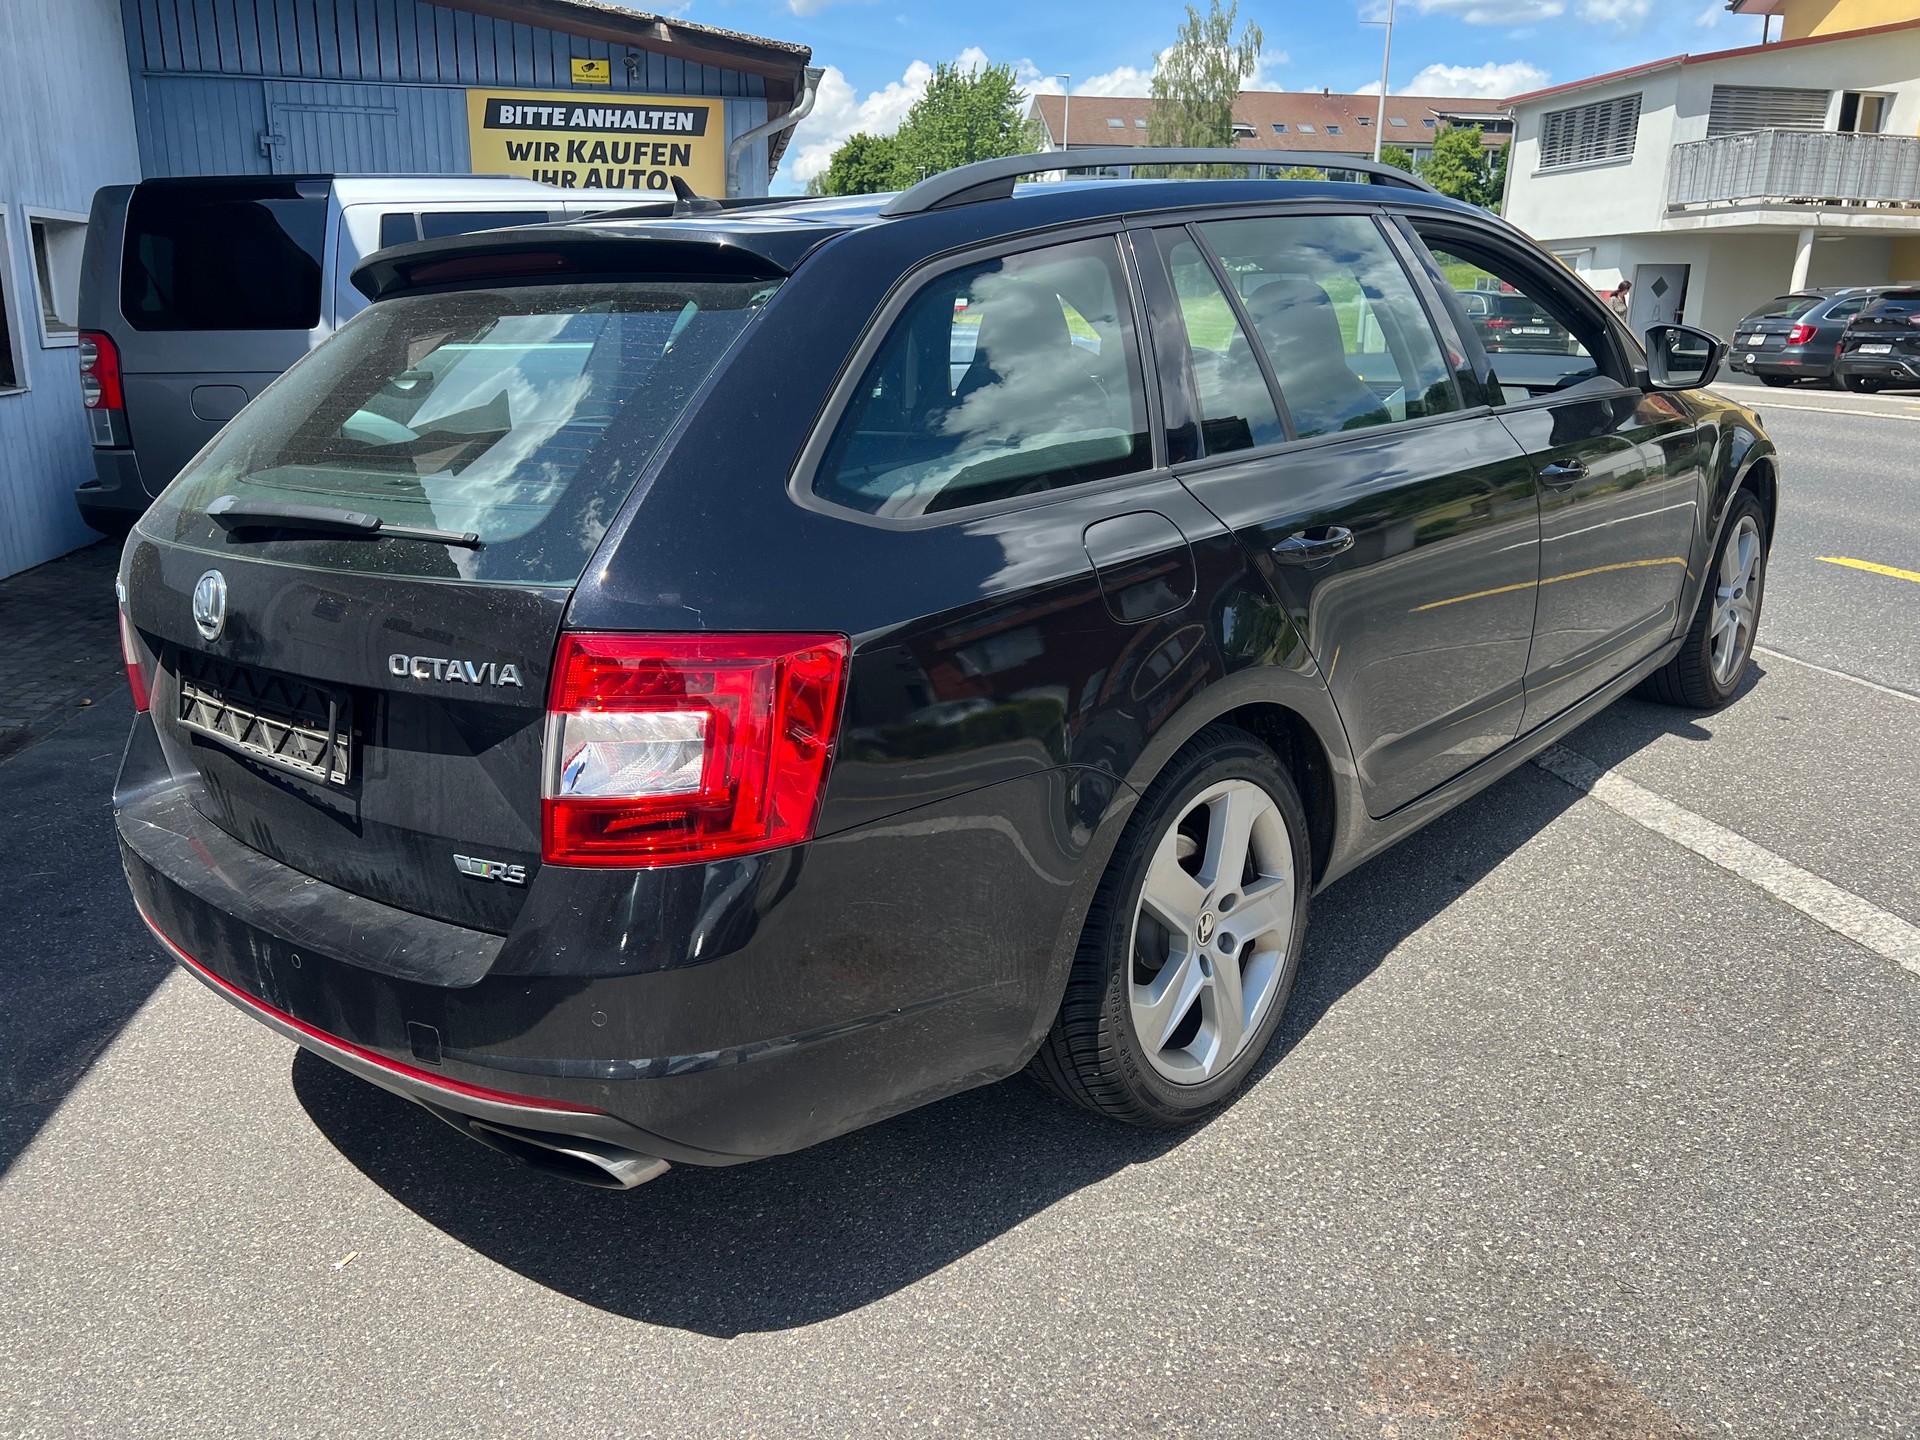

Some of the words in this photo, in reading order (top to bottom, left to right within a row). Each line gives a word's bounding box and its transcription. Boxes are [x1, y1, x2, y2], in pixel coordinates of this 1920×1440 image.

[500, 105, 567, 126] BITTE
[569, 109, 694, 131] ANHALTEN
[505, 141, 560, 163] WIR
[566, 139, 692, 167] KAUFEN
[532, 169, 577, 189] IHR
[583, 168, 668, 191] AUTO
[388, 653, 524, 687] OCTAVIA
[1111, 924, 1125, 1025] PERFORMER
[1120, 1045, 1139, 1079] STAR
